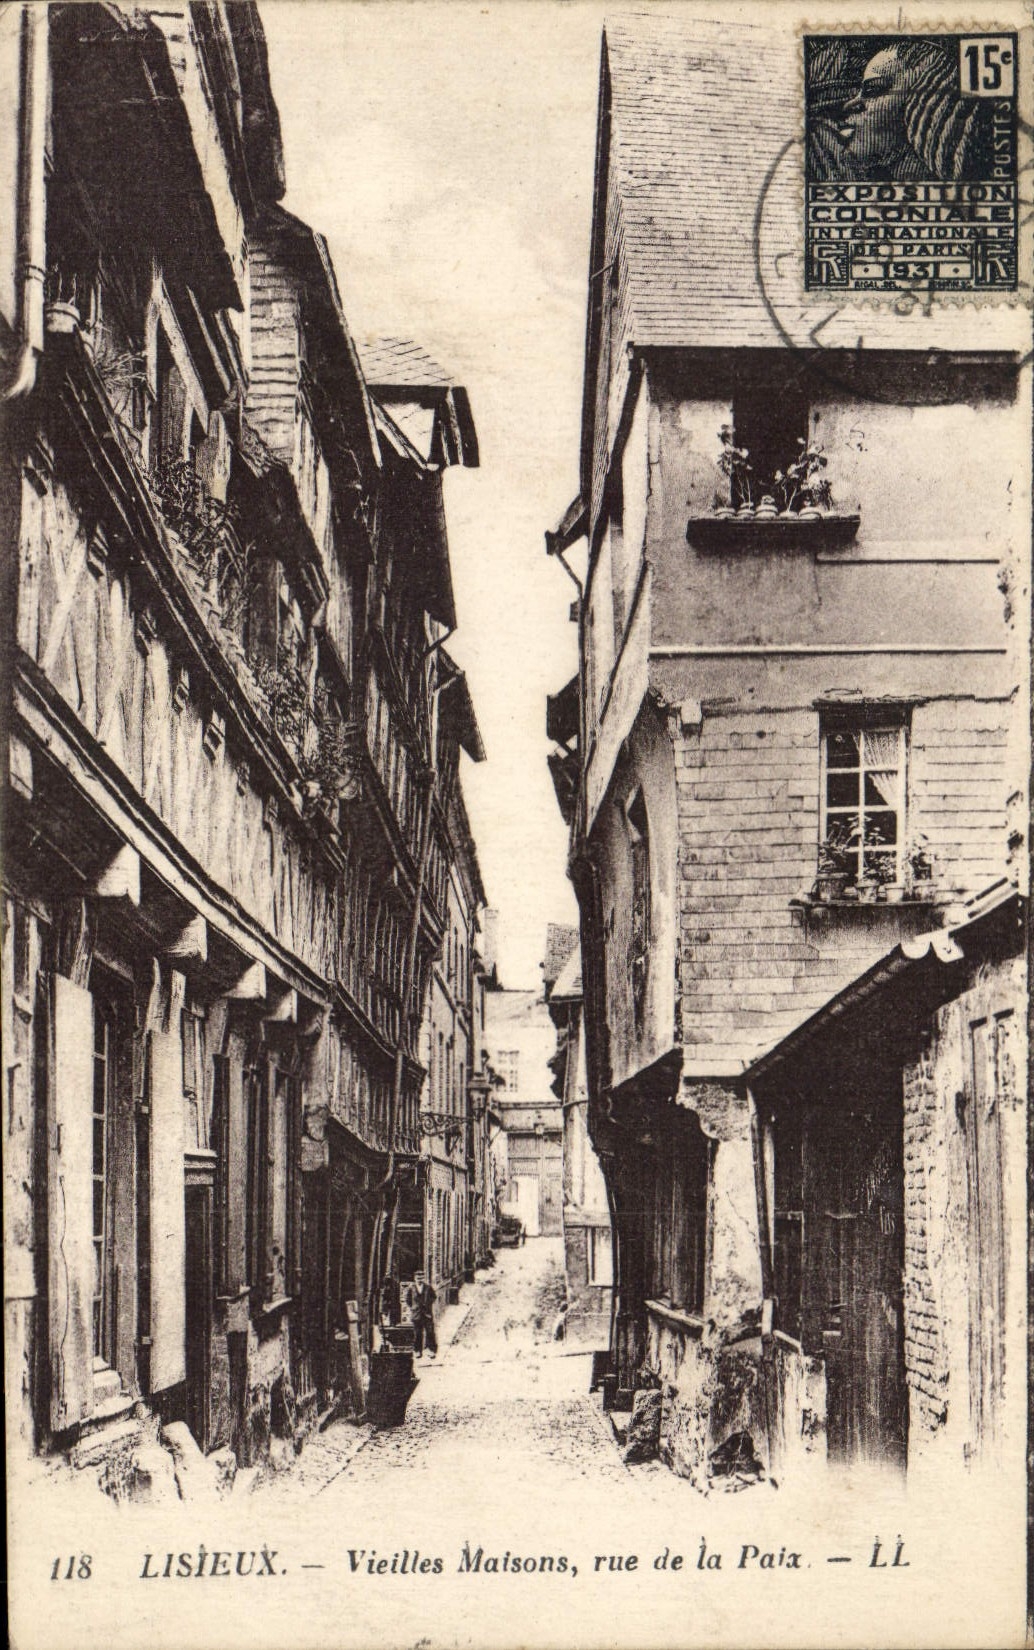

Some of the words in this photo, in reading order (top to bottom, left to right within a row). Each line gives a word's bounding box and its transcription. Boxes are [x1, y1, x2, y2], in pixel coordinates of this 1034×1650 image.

[994, 101, 1011, 178] POSTES
[811, 185, 1012, 201] EXPOSITION
[811, 206, 1011, 222] COLONIALE
[811, 227, 1011, 239] INTERNATIONALE
[902, 243, 969, 256] PARIS
